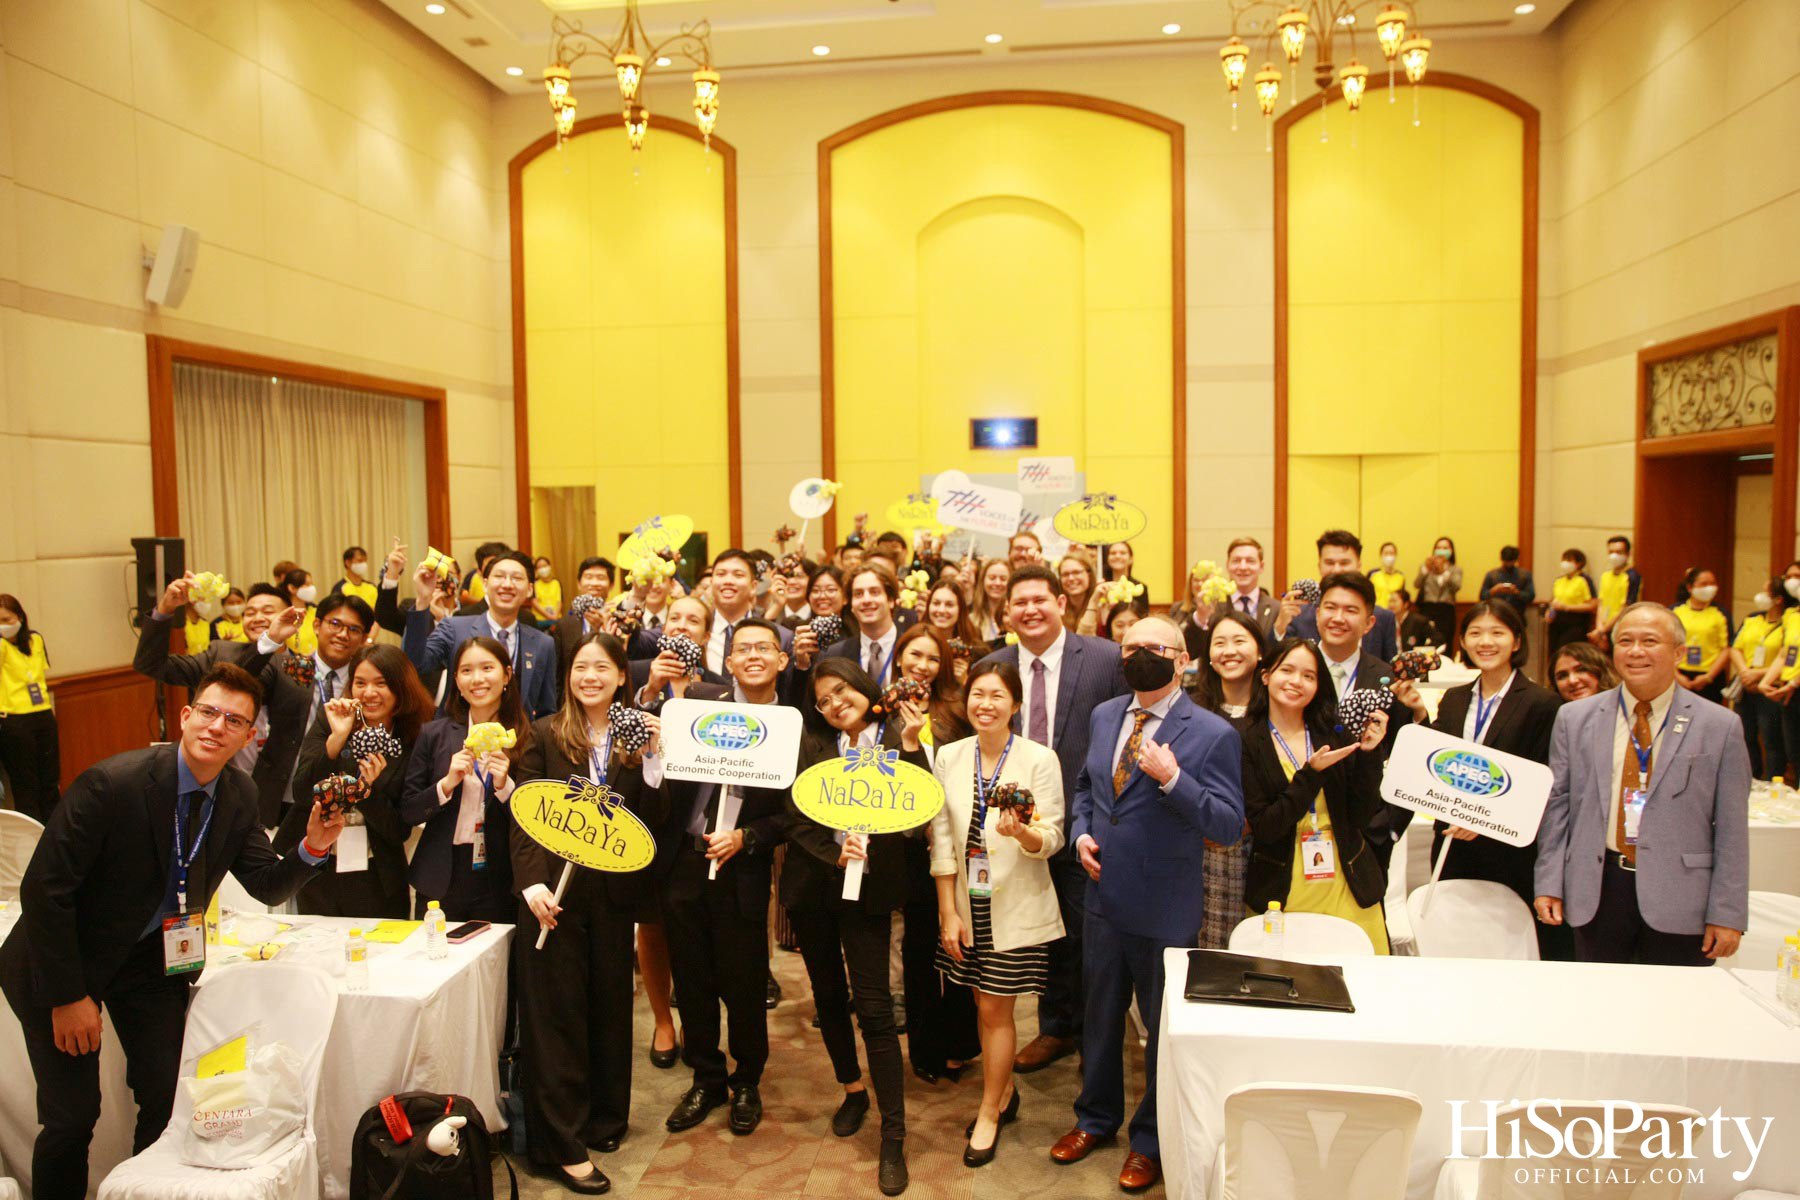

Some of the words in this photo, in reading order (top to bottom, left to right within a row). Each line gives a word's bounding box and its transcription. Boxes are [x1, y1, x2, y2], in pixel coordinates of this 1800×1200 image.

[1069, 513, 1129, 530] NaRaYa
[709, 723, 749, 739] APEC
[666, 762, 716, 775] Economic
[718, 767, 781, 781] Cooperation
[695, 755, 755, 768] Asia-Pacific
[1446, 761, 1491, 785] APEC
[818, 777, 916, 811] NaRaYa
[1426, 788, 1492, 817] Asia-Pacific
[1394, 788, 1447, 814] Economic
[1450, 808, 1519, 838] Cooperation
[533, 795, 627, 858] NaRaYa
[193, 1108, 252, 1121] CENTARA
